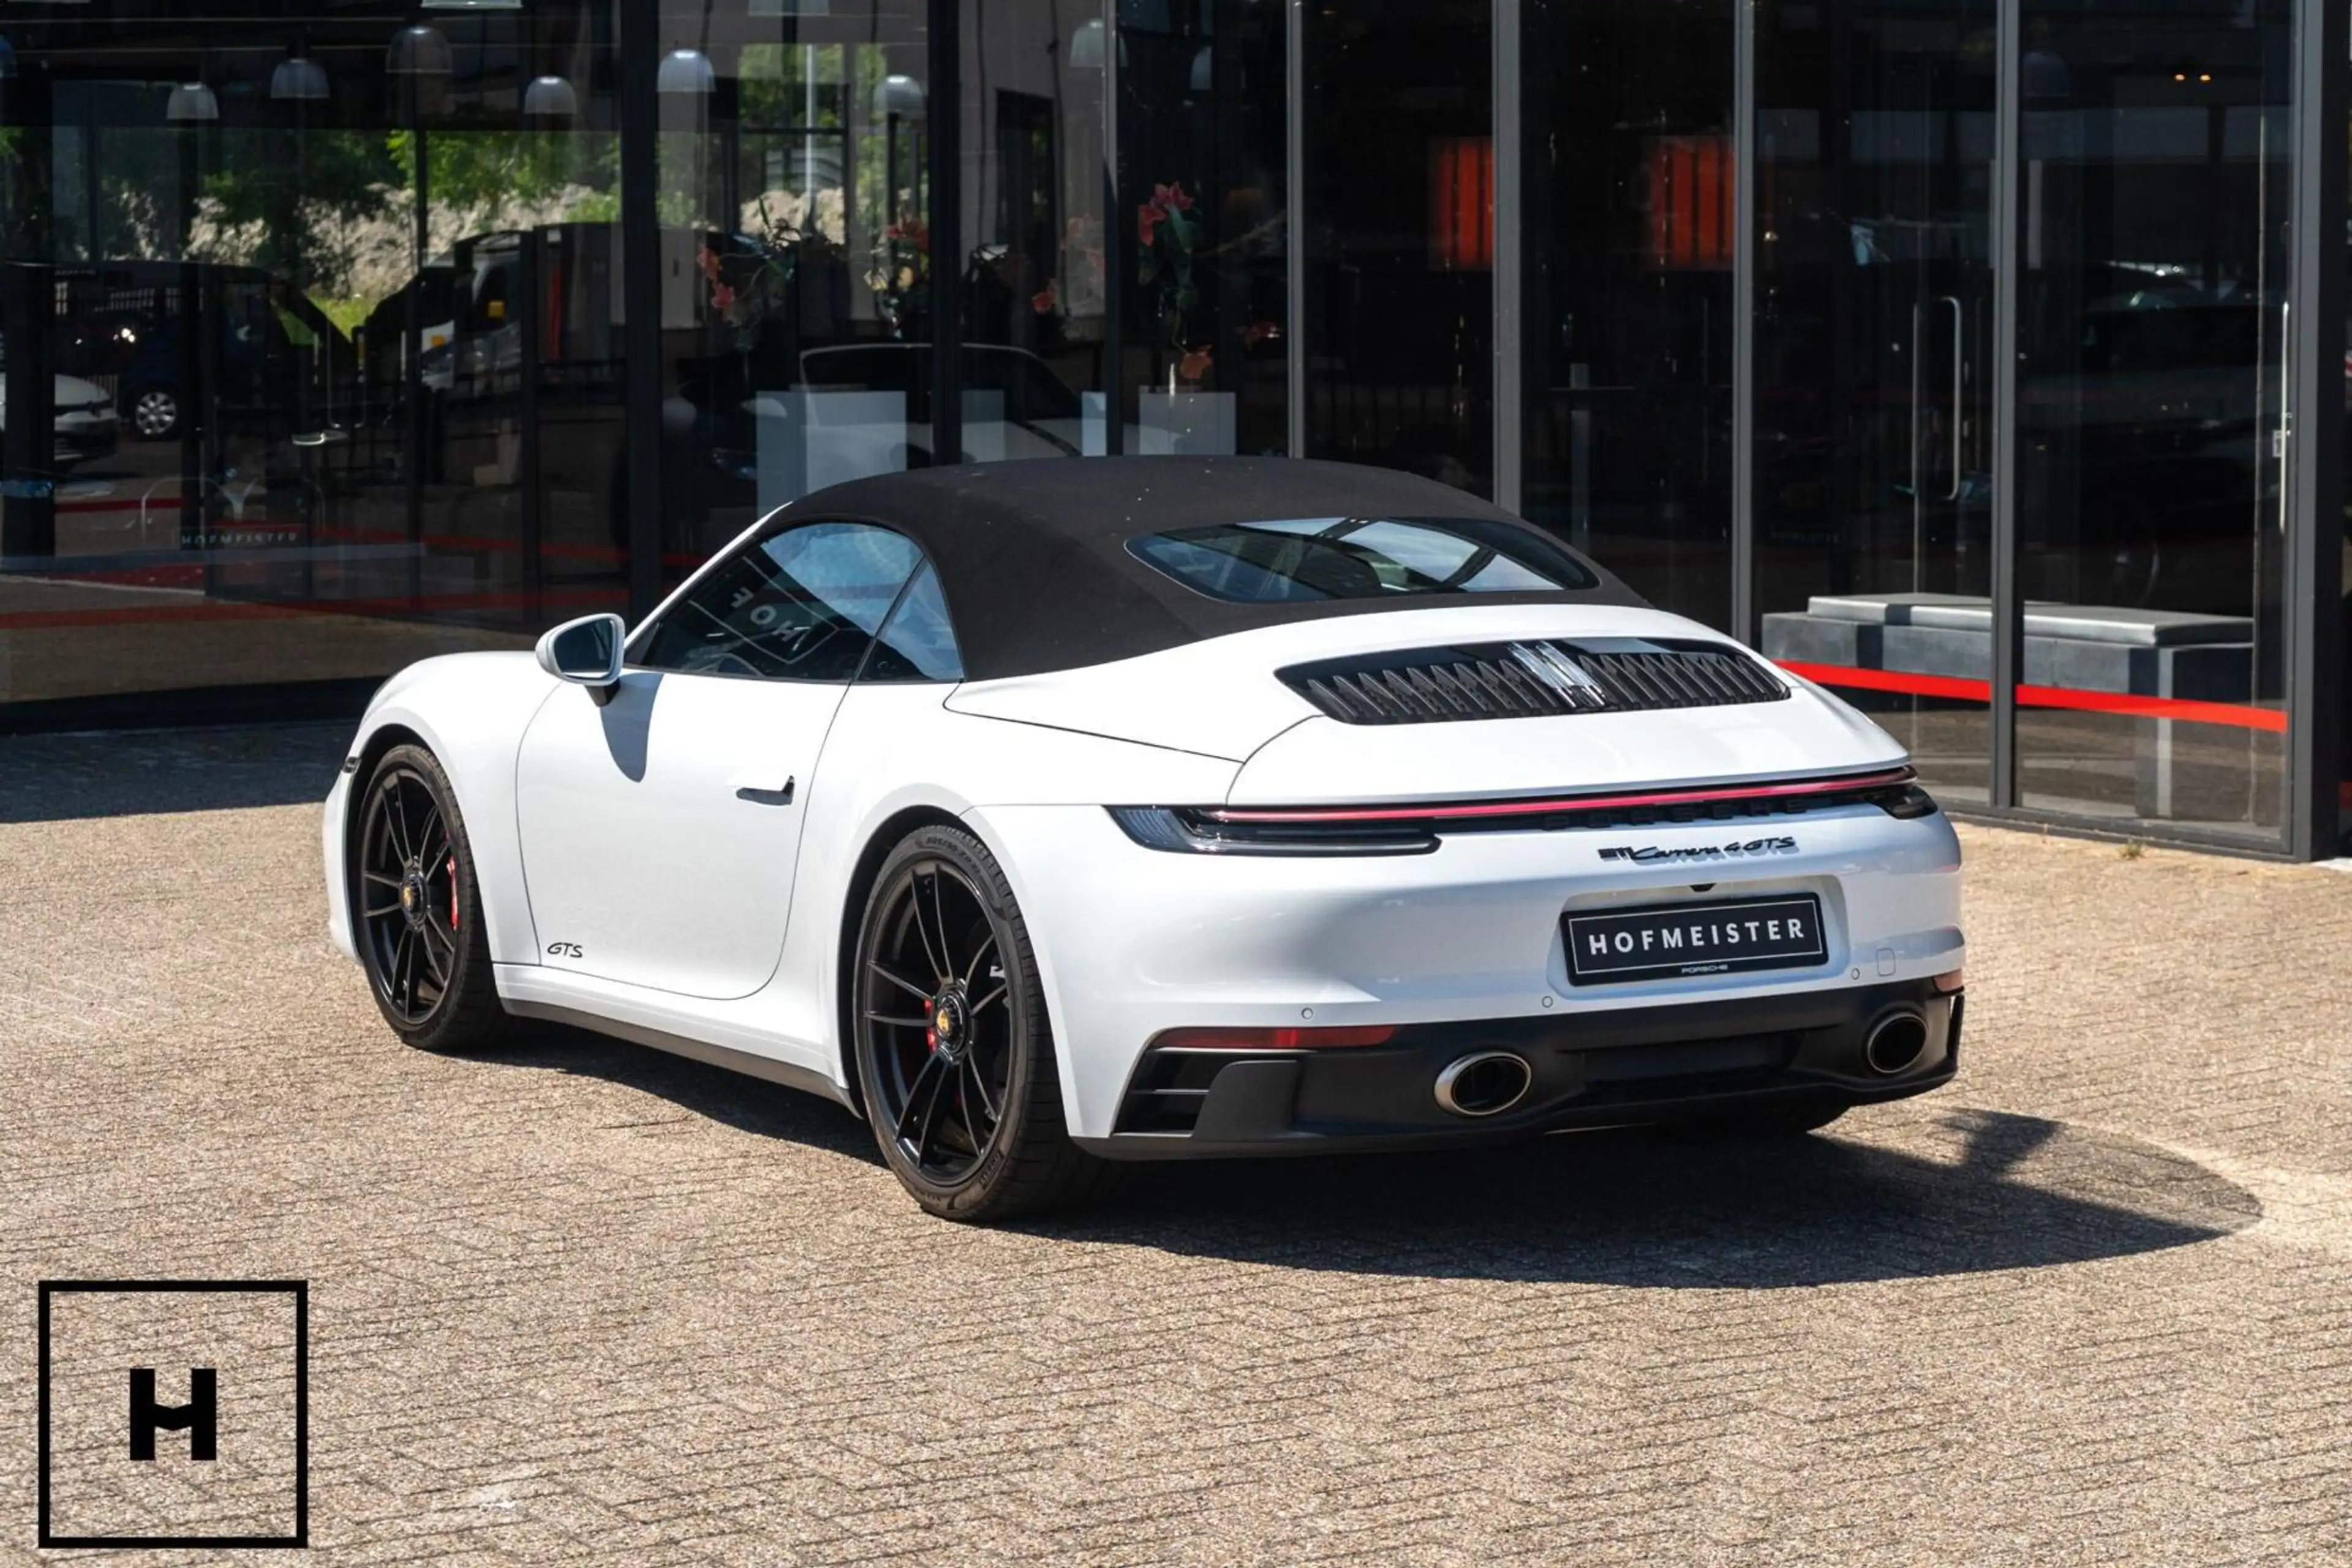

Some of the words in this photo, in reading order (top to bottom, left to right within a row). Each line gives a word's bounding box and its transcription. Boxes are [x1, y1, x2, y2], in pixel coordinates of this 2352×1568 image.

[1630, 846, 1720, 861] Carrera
[1724, 841, 1741, 852] 4
[1743, 835, 1796, 851] GTS
[547, 942, 582, 958] GTS
[1588, 918, 1804, 956] HOFMEISTER
